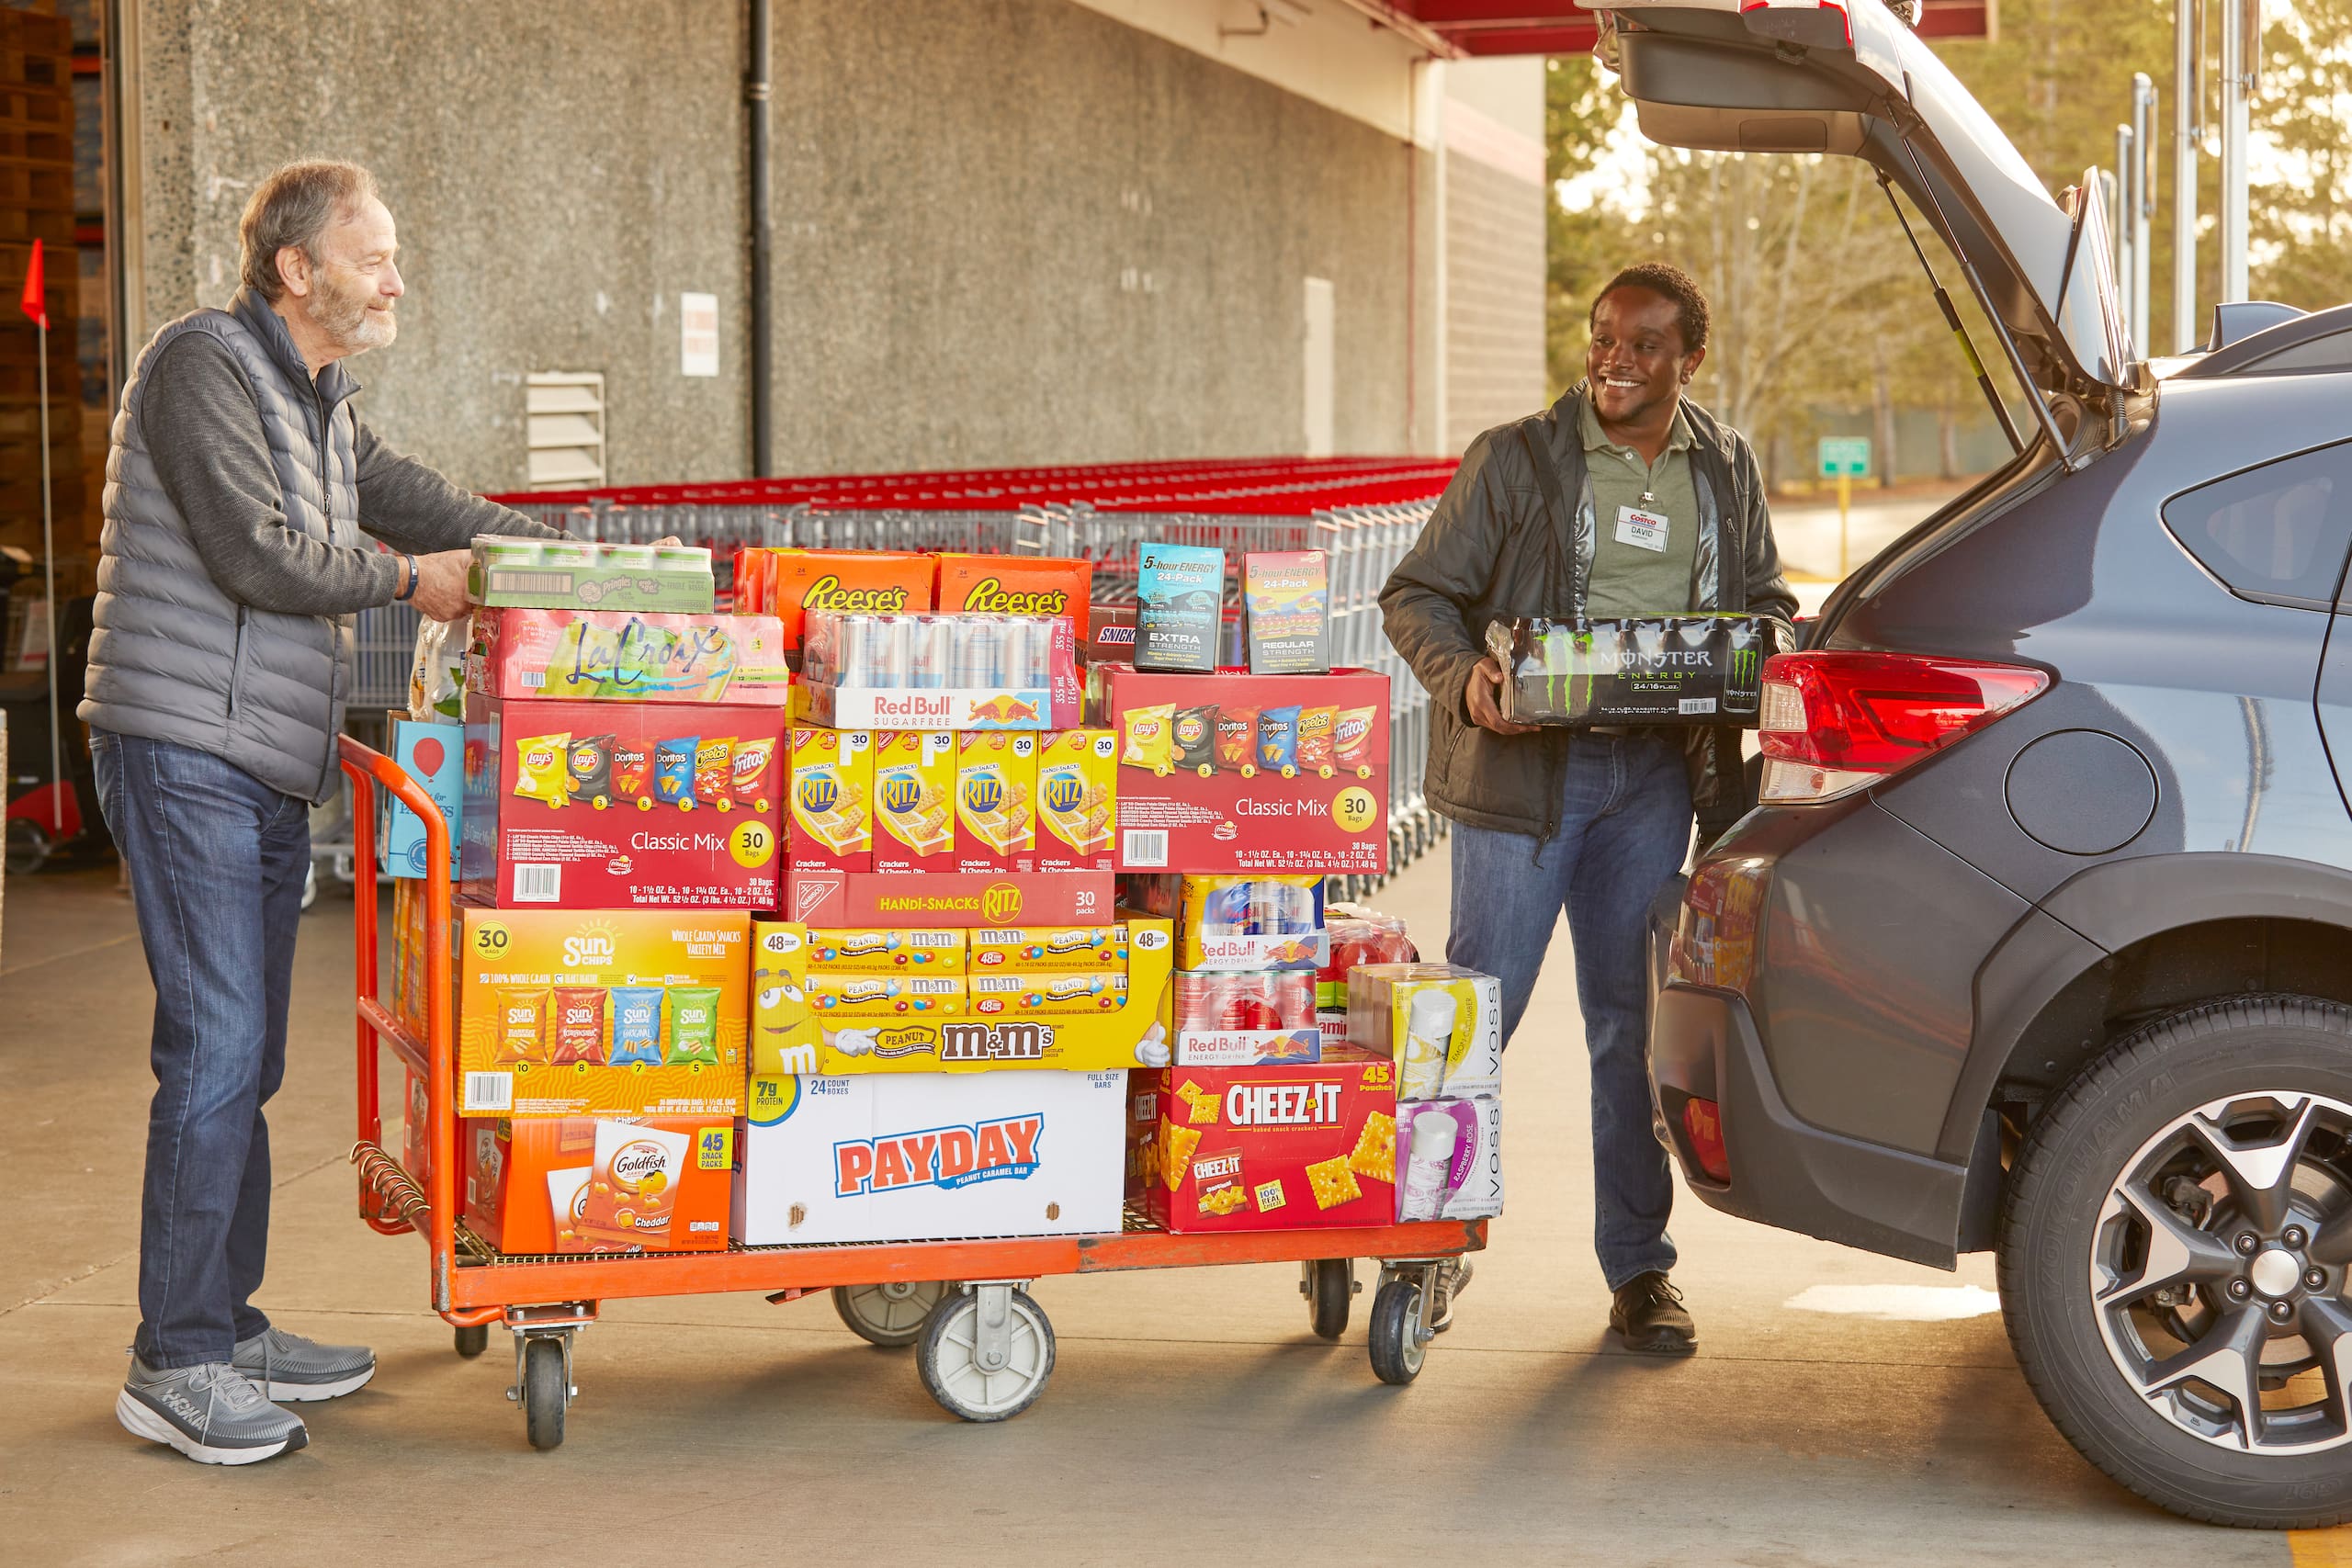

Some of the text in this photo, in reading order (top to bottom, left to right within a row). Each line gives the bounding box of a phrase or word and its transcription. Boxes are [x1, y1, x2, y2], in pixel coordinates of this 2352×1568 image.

[1630, 513, 1657, 525] COSTCO
[1631, 525, 1653, 537] DAVID
[1143, 556, 1217, 574] 5-hour ENERGY
[1249, 565, 1322, 579] 5-hour ENERGY
[1156, 572, 1204, 583] 24-Pack
[1262, 579, 1309, 589] 24-Pack
[601, 575, 633, 596] Pringles
[802, 574, 909, 612] Reese's
[963, 576, 1069, 614] Reese's
[1055, 635, 1065, 650] 355
[1099, 627, 1136, 643] SNICK
[1148, 632, 1201, 644] EXTRA
[1148, 642, 1201, 651] STRENGTH
[1261, 640, 1315, 649] REGULAR
[1600, 649, 1713, 669] MONSTER
[1617, 671, 1697, 680] ENERGY
[1054, 675, 1065, 705] 355 mL
[874, 695, 951, 716] Red Bull
[874, 717, 952, 727] SUGARFREE
[1134, 721, 1159, 736] Lay's
[1179, 722, 1202, 737] Lay's
[1217, 721, 1248, 732] Doritos
[1258, 722, 1289, 733] Doritos
[1297, 714, 1329, 737] Cheetos
[1335, 719, 1366, 744] Fritos
[852, 735, 867, 744] 30
[934, 736, 951, 746] 30
[1015, 740, 1032, 750] 30
[1097, 741, 1113, 750] 30
[526, 751, 553, 766] Lay's
[572, 753, 597, 767] Lay's
[614, 752, 645, 763] Doritos
[656, 752, 686, 763] Doritos
[695, 745, 728, 769] Cheetos
[733, 750, 765, 776] Fritos
[434, 792, 447, 803] for
[798, 778, 838, 808] RITZ
[881, 779, 921, 809] RITZ
[964, 778, 1001, 808] RITZ
[1045, 778, 1081, 808] RITZ
[1235, 797, 1294, 817] Classic
[1296, 798, 1329, 817] Mix
[1344, 797, 1366, 814] 30
[1347, 815, 1363, 823] Bags
[630, 831, 690, 852] Classic
[694, 832, 726, 852] Mix
[741, 832, 763, 849] 30
[745, 849, 761, 859] Bags
[749, 877, 775, 887] 30 Bags:
[632, 895, 775, 907] Total Net Wt. lbs. OZ.) 1.48 kg
[801, 886, 824, 908] NABISCO
[984, 887, 1022, 919] RITZ
[1075, 891, 1096, 907] 30
[1075, 907, 1096, 916] packs
[478, 930, 508, 948] 30
[671, 929, 741, 943] WHOLE GRAIN SNACKS
[767, 935, 785, 951] 48
[848, 936, 879, 947] PEANUT
[910, 931, 957, 947] m&m's
[979, 929, 1026, 944] m&m's
[1053, 933, 1085, 945] PEANUT
[1138, 932, 1153, 947] 48
[562, 936, 616, 967] Sun
[686, 942, 726, 956] VARIETY MIX
[1200, 941, 1255, 956] Red Bull
[581, 955, 614, 965] CHIPS
[979, 953, 993, 964] 48
[490, 973, 551, 985] 100% GRAIN
[910, 978, 957, 994] m&m's
[978, 976, 1026, 992] m&m's
[1052, 980, 1084, 992] PEANUT
[848, 983, 879, 994] PEANUT
[979, 1000, 992, 1011] 48
[507, 1008, 537, 1025] Sun
[565, 1008, 594, 1025] Sun
[623, 1009, 651, 1025] Sun
[680, 1009, 707, 1025] Sun
[1464, 997, 1474, 1043] CUCUMBER
[886, 1032, 925, 1045] PEANUT
[1488, 985, 1499, 1077] VOSS
[942, 1022, 1054, 1061] m&m's
[1188, 1035, 1247, 1052] Red Bull
[578, 1064, 585, 1073] 8
[636, 1064, 642, 1073] 7
[694, 1064, 699, 1073] 5
[1362, 1066, 1390, 1084] 45
[827, 1079, 850, 1088] COUNT
[1087, 1072, 1120, 1082] FULL SIZE
[1093, 1080, 1112, 1089] BARS
[756, 1080, 777, 1097] 7g
[810, 1079, 827, 1095] 24
[1359, 1084, 1393, 1093] Pouches
[756, 1097, 783, 1106] PROTEIN
[702, 1133, 725, 1151] 45
[701, 1151, 724, 1160] SNACK
[835, 1113, 1043, 1196] PAYDAY
[1453, 1123, 1474, 1182] RASPBERRY ROSE
[1489, 1108, 1500, 1198] VOSS
[616, 1155, 668, 1174] Goldfish
[701, 1160, 724, 1168] PACKS
[956, 1167, 1028, 1186] PEANUT CARAMEL BAR
[2039, 1069, 2179, 1301] YOKOHAMA
[1259, 1187, 1280, 1199] 100%
[1261, 1195, 1282, 1206] REAL
[1263, 1201, 1283, 1210] CHEESE
[635, 1214, 672, 1229] Cheddar
